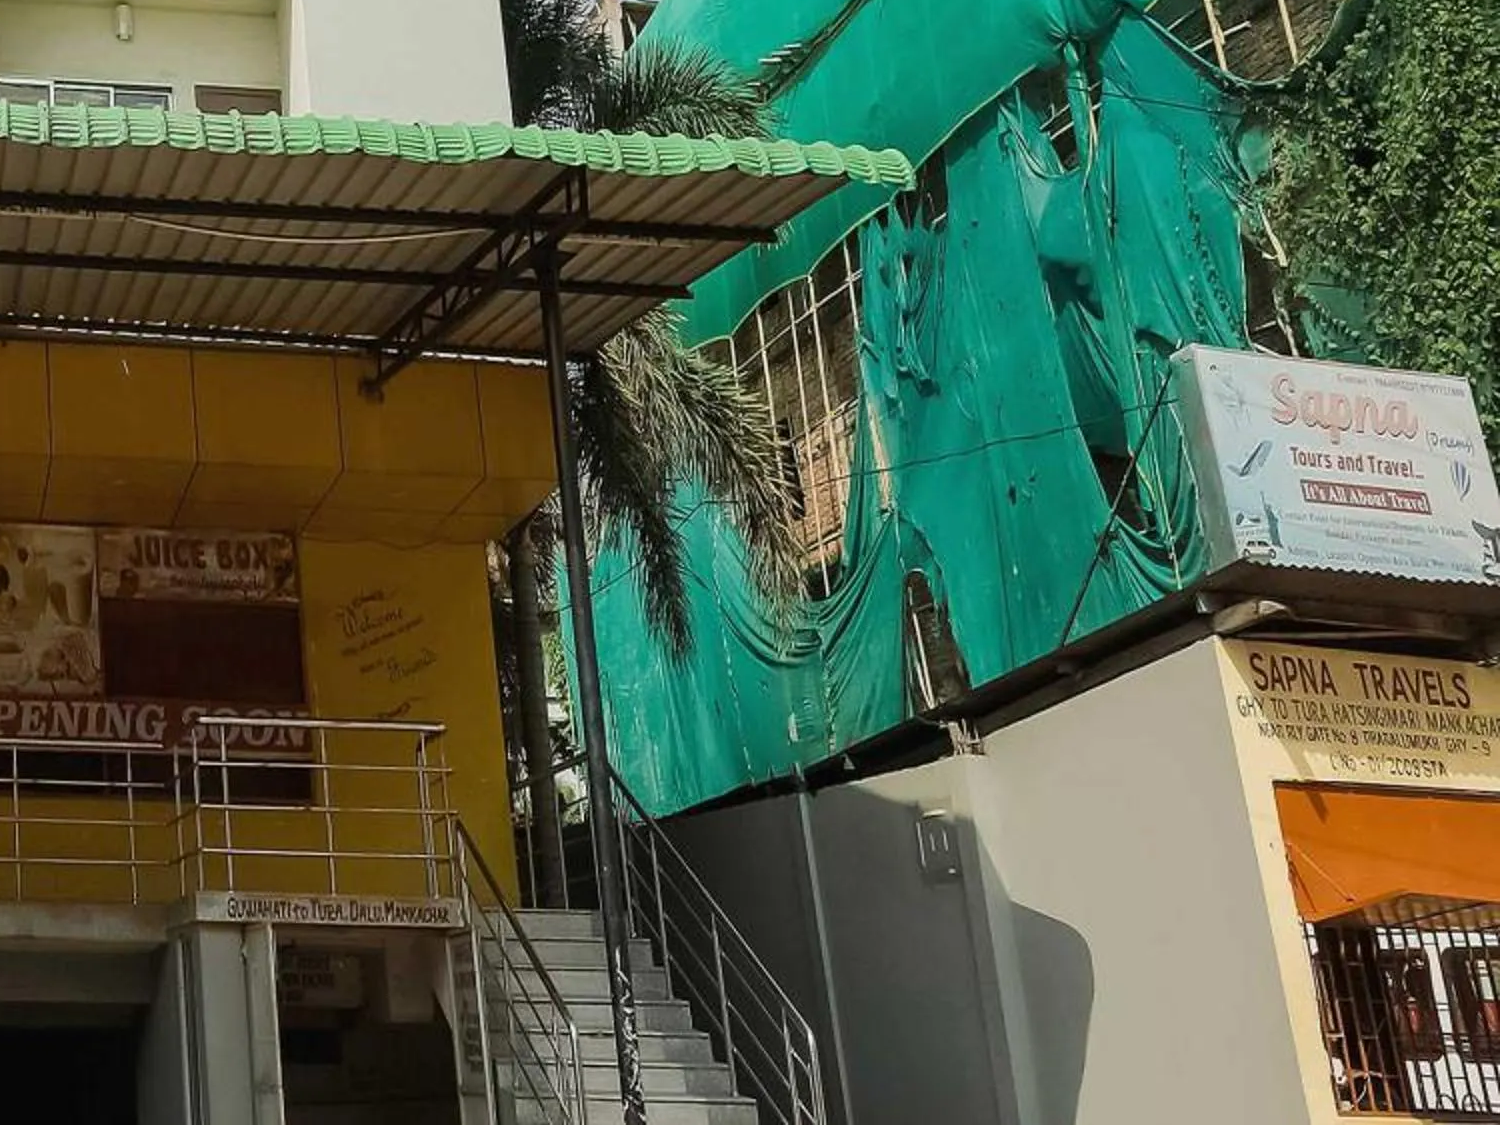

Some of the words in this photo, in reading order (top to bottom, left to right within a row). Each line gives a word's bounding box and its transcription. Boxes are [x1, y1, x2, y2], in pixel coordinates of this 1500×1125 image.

[1269, 372, 1419, 445] Sapna
[1289, 446, 1333, 470] Tours
[1337, 454, 1364, 473] and
[1303, 482, 1327, 501] It's
[1328, 484, 1347, 503] All
[1348, 487, 1387, 508] About
[1387, 491, 1430, 513] Travel
[129, 535, 207, 568] JUICE
[216, 539, 269, 570] BOX
[1249, 652, 1339, 697] SAPNA
[1352, 662, 1471, 709] TRAVELS
[181, 705, 308, 747] SOON
[1237, 695, 1265, 718] GHY
[1270, 697, 1289, 720] TO
[1291, 698, 1331, 725] TURA
[227, 896, 291, 919] GUWAHATI
